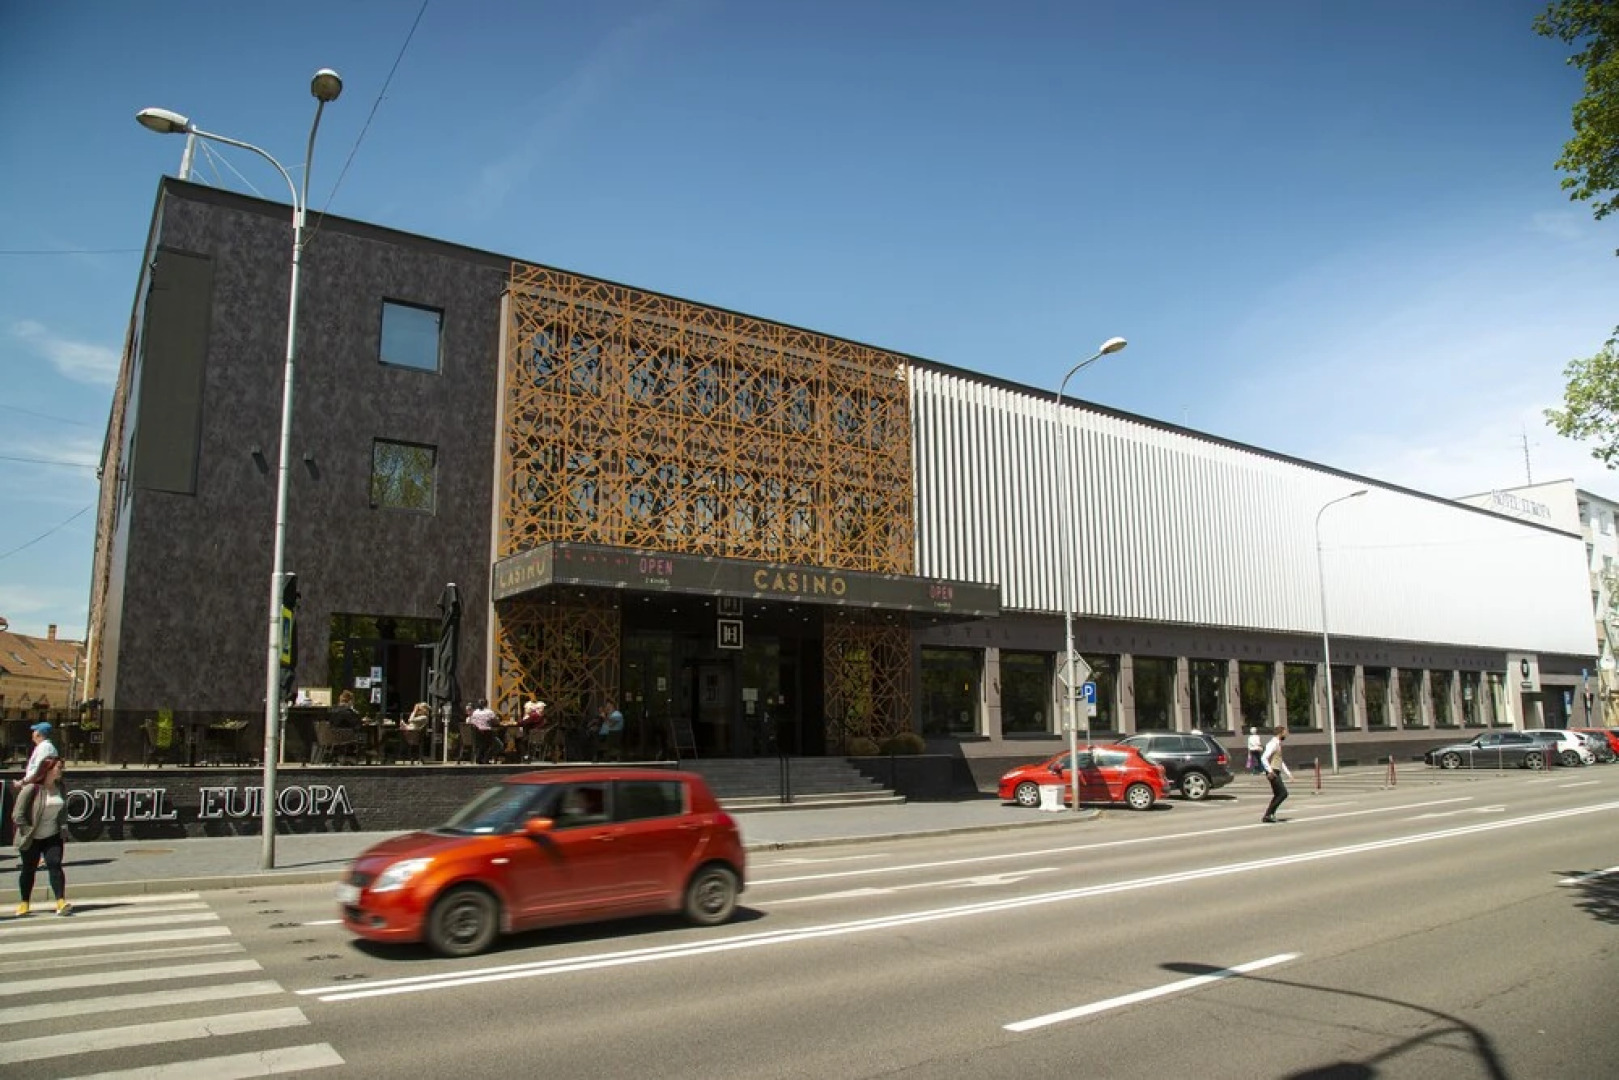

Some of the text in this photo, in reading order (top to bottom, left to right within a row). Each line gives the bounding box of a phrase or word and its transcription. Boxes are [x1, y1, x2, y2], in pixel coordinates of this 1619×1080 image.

[640, 558, 672, 575] OPEN
[753, 569, 846, 595] CASINO
[67, 787, 178, 823] OTEL
